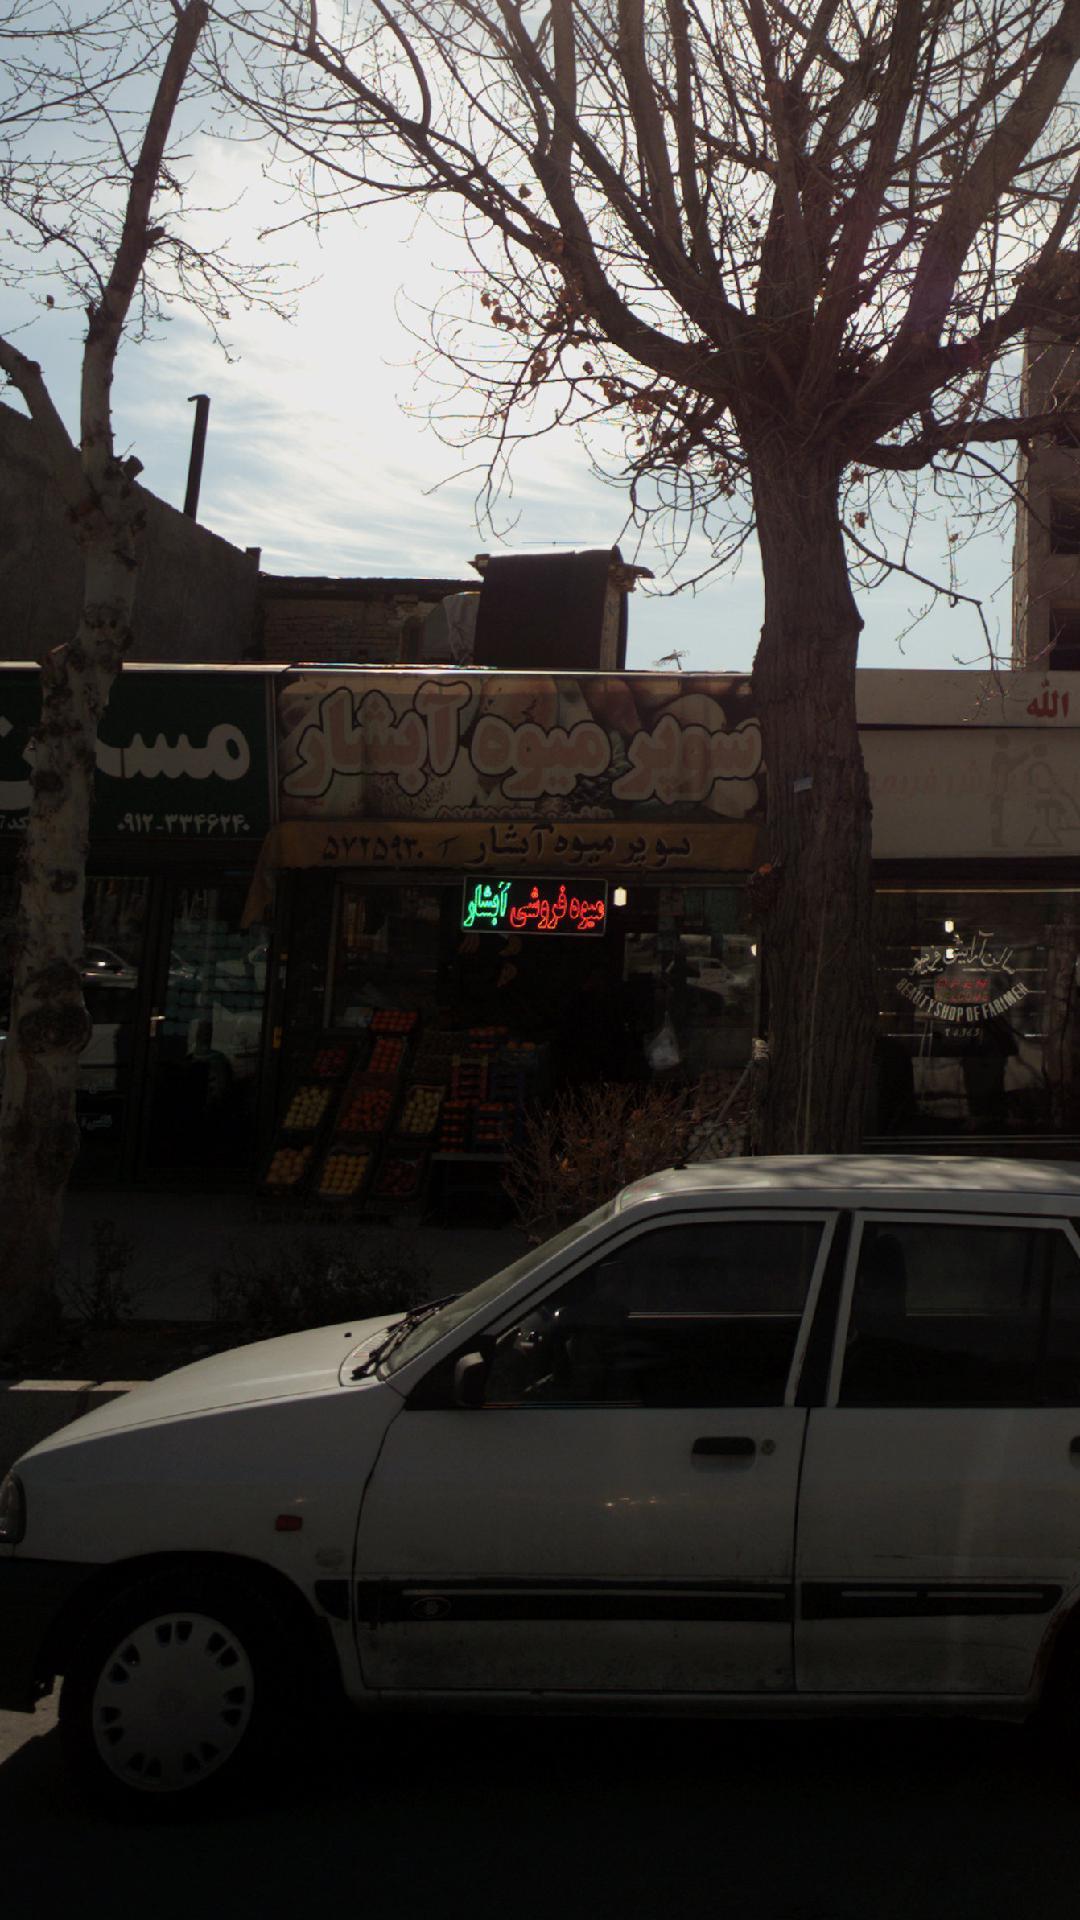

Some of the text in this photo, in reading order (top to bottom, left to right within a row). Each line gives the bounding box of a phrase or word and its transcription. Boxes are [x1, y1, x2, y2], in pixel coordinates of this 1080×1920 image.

[1026, 678, 1070, 718] الله
[280, 680, 472, 798] آبشار
[468, 712, 612, 800] میوه
[611, 713, 762, 805] سوپر
[463, 824, 554, 865] آبشار
[553, 834, 615, 865] میوه
[463, 881, 605, 930] میوه فروشی آبشار
[896, 978, 934, 1013] BEAUTY
[933, 1001, 964, 1022] SHOP
[966, 1005, 980, 1022] OF
